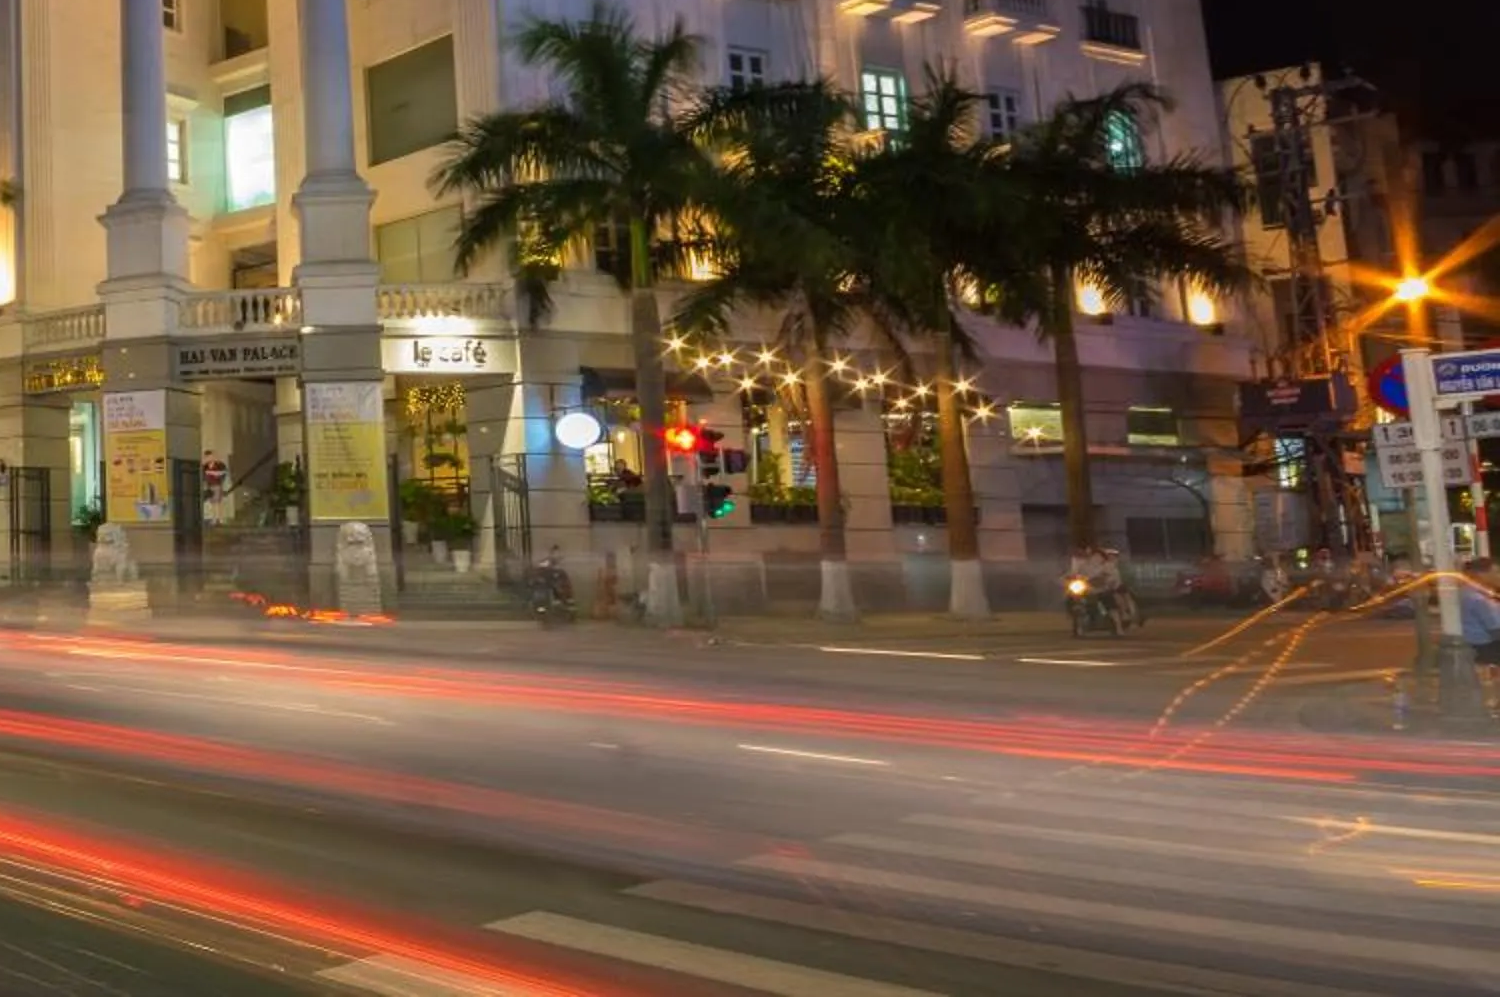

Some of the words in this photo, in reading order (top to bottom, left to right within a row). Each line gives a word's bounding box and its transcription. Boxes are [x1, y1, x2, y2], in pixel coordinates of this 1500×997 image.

[180, 350, 204, 364] HAI
[210, 348, 237, 361] VAN
[243, 345, 298, 361] PALACE
[413, 339, 433, 363] le
[439, 339, 487, 363] café
